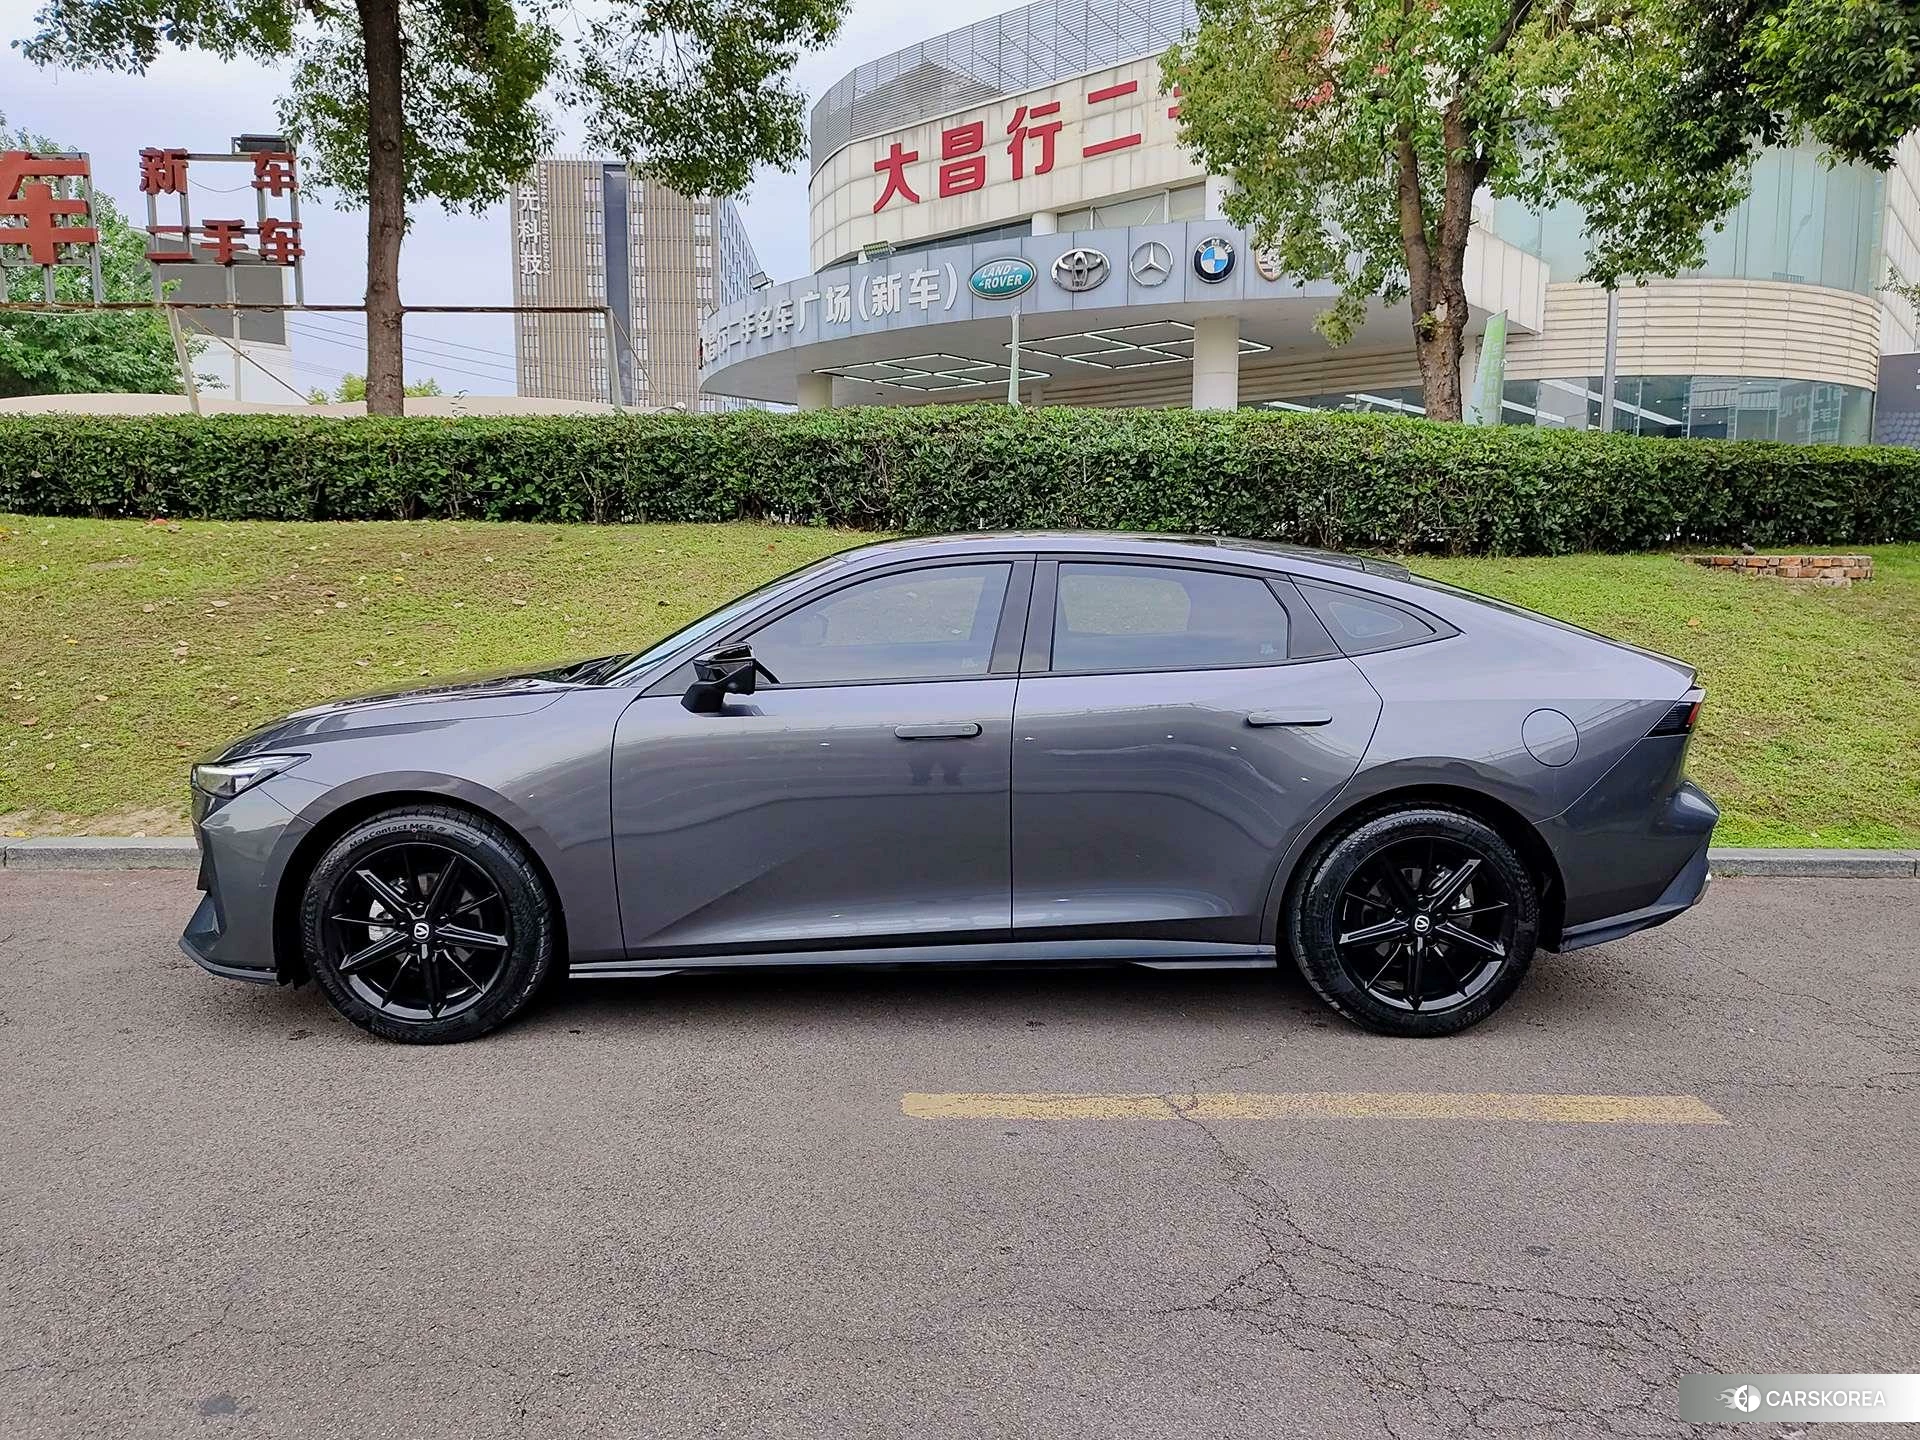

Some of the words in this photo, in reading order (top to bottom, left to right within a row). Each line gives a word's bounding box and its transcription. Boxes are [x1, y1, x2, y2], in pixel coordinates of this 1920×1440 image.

[873, 80, 1182, 214] 大昌行二
[145, 218, 304, 264] 二手车
[517, 164, 543, 275] 先科技
[982, 264, 1012, 278] LAND
[984, 274, 1023, 289] ROVER
